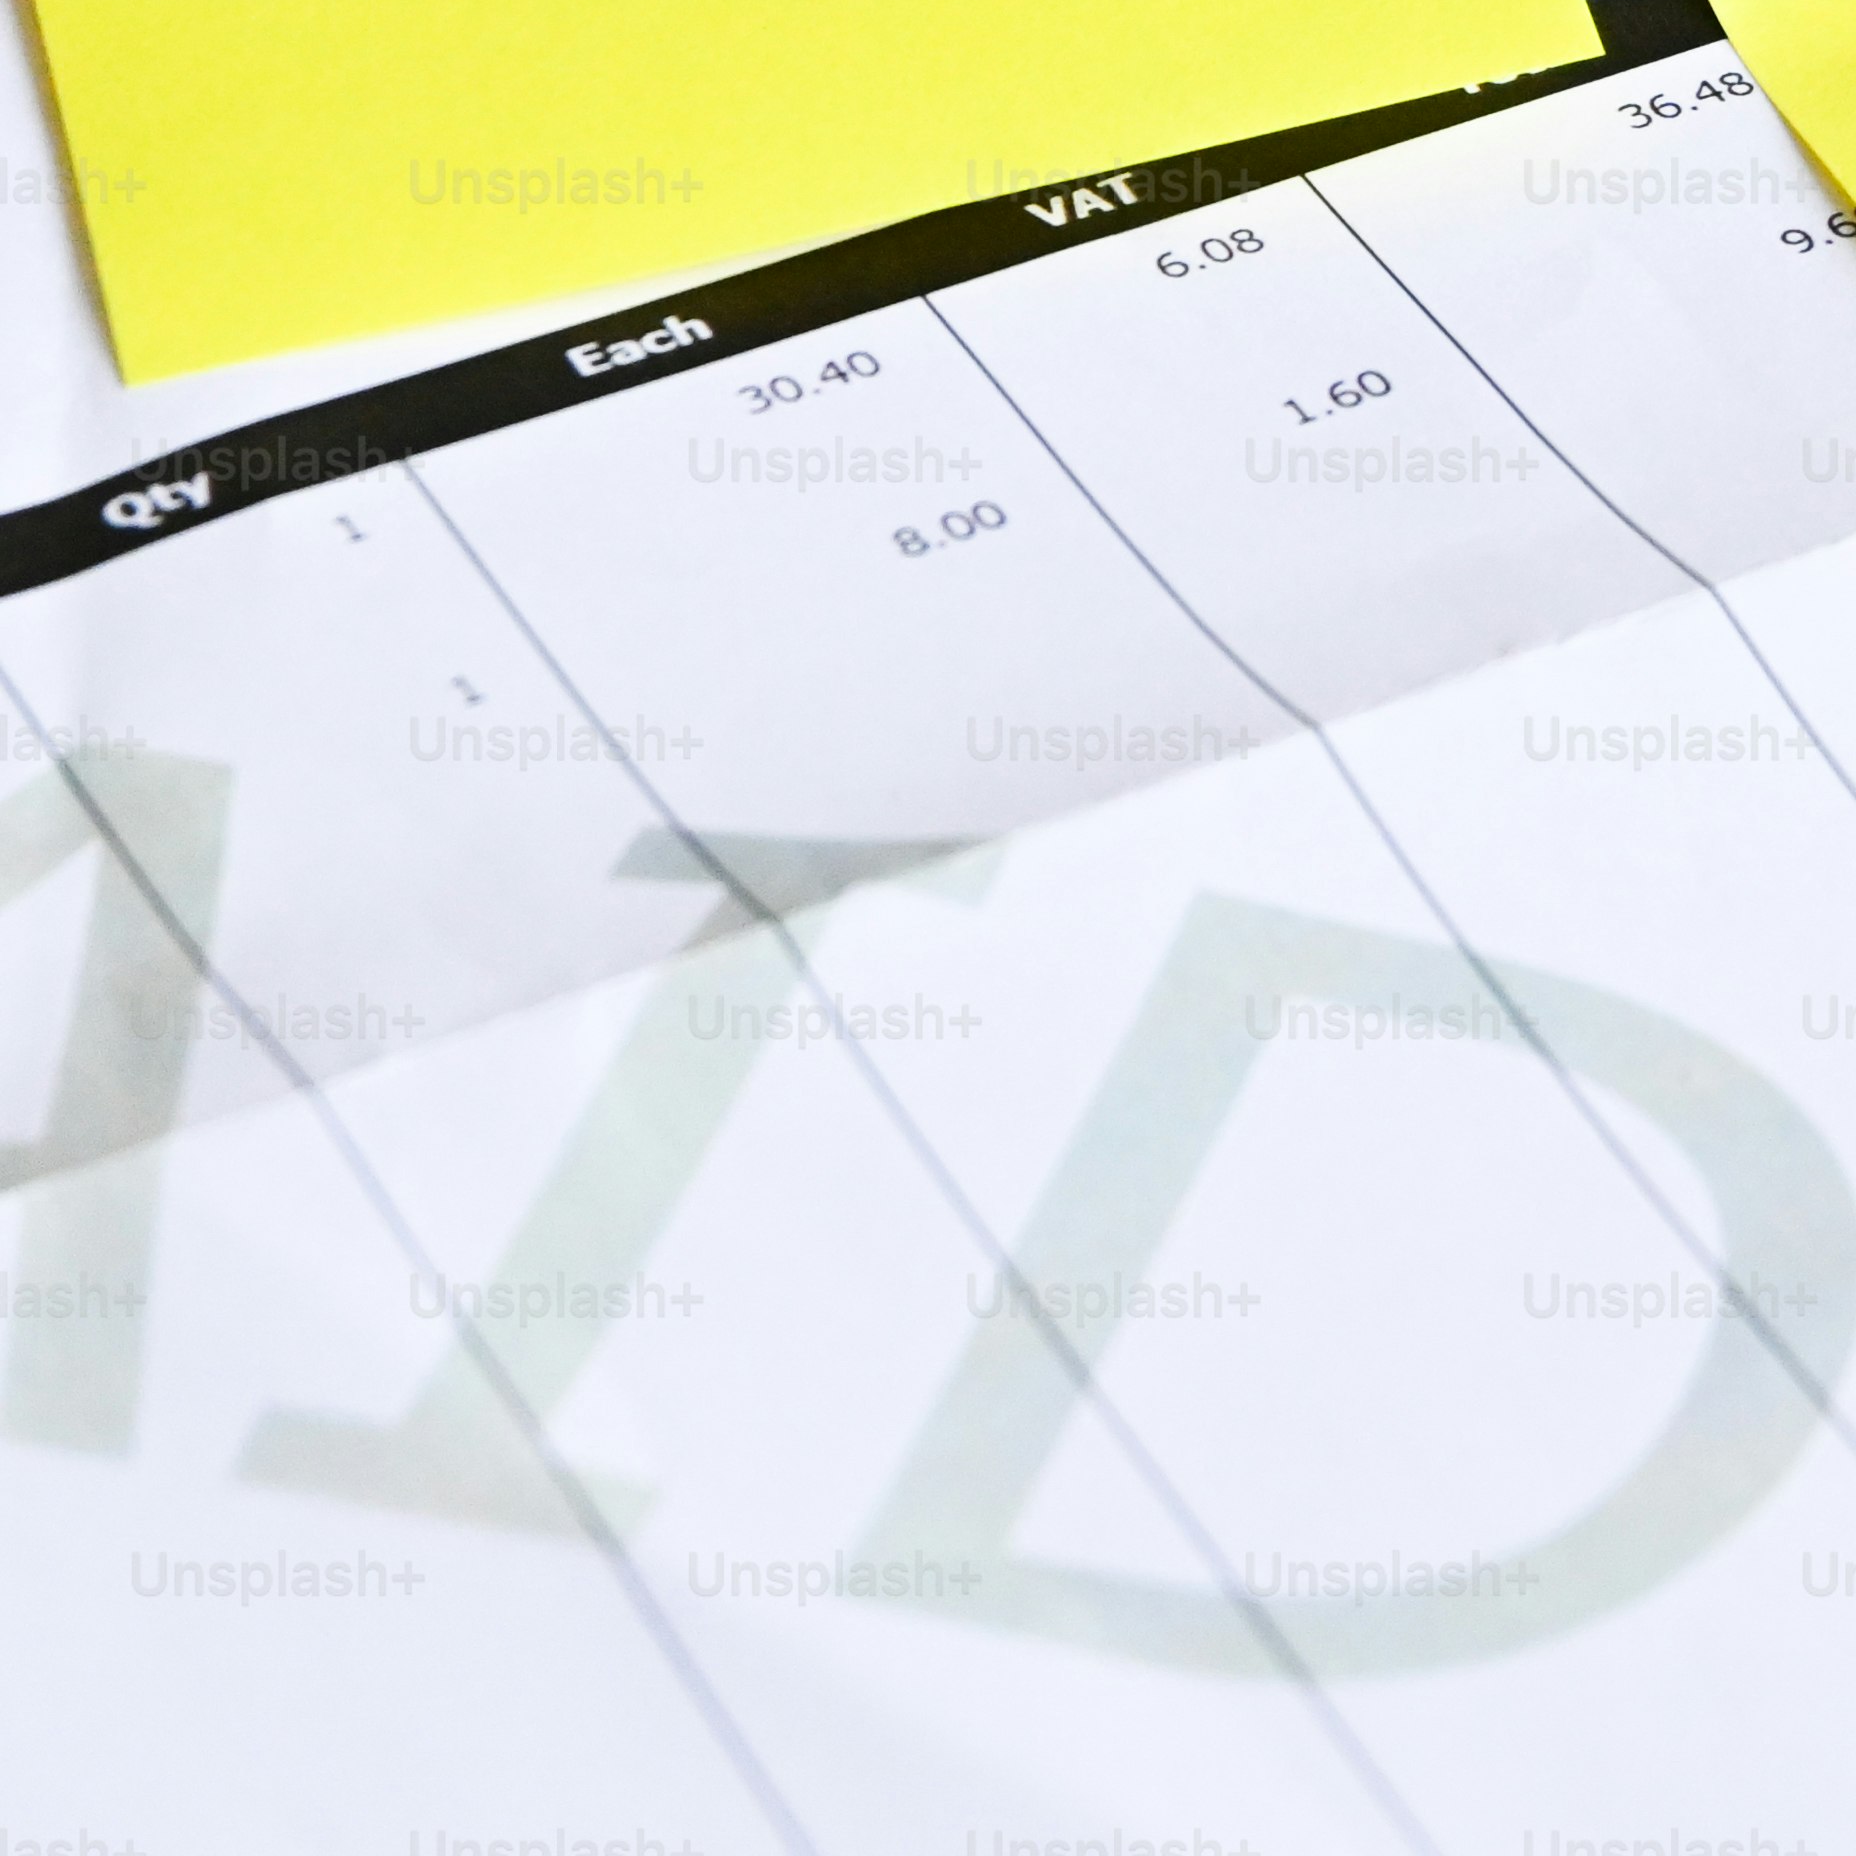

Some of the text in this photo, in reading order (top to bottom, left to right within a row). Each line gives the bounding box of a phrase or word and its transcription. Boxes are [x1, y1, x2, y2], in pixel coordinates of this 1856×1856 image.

[1617, 71, 1756, 130] 36.48
[99, 173, 1143, 531] Qty Each VAT
[336, 228, 1266, 544] 1 30.40 6.08
[892, 500, 1009, 559] 8.00
[1283, 370, 1394, 426] 1.60
